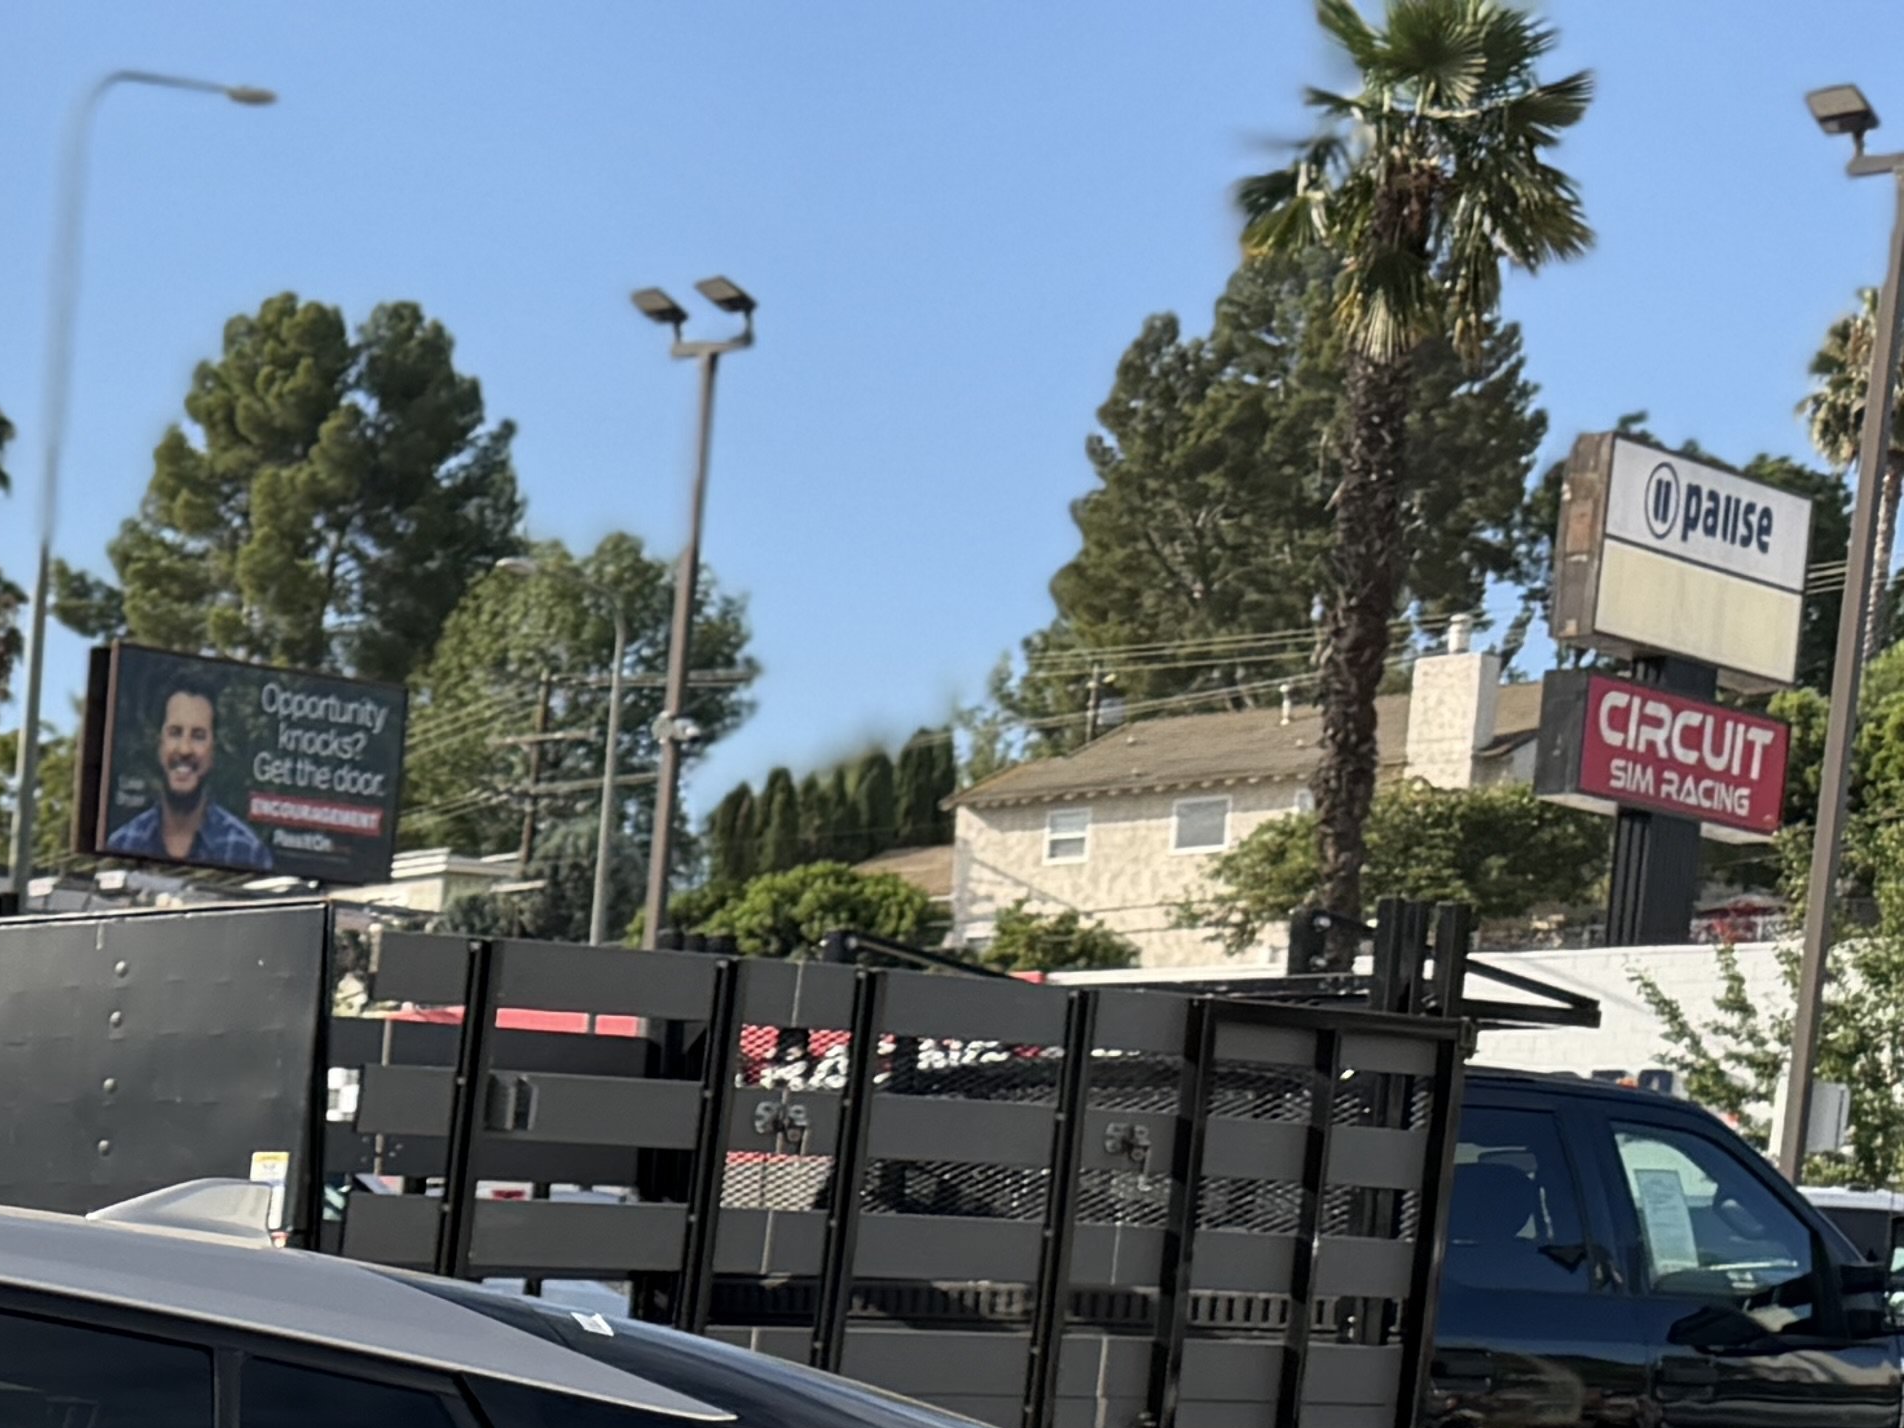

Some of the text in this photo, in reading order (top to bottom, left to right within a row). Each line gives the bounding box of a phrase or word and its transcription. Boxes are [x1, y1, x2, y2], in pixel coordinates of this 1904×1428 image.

[1681, 482, 1774, 555] pause
[261, 682, 389, 734] Opportunity
[278, 721, 368, 760] knocks?
[1599, 691, 1775, 780] CIRCUIT
[253, 752, 387, 796] Get the door.
[1610, 759, 1751, 816] SIM RACING
